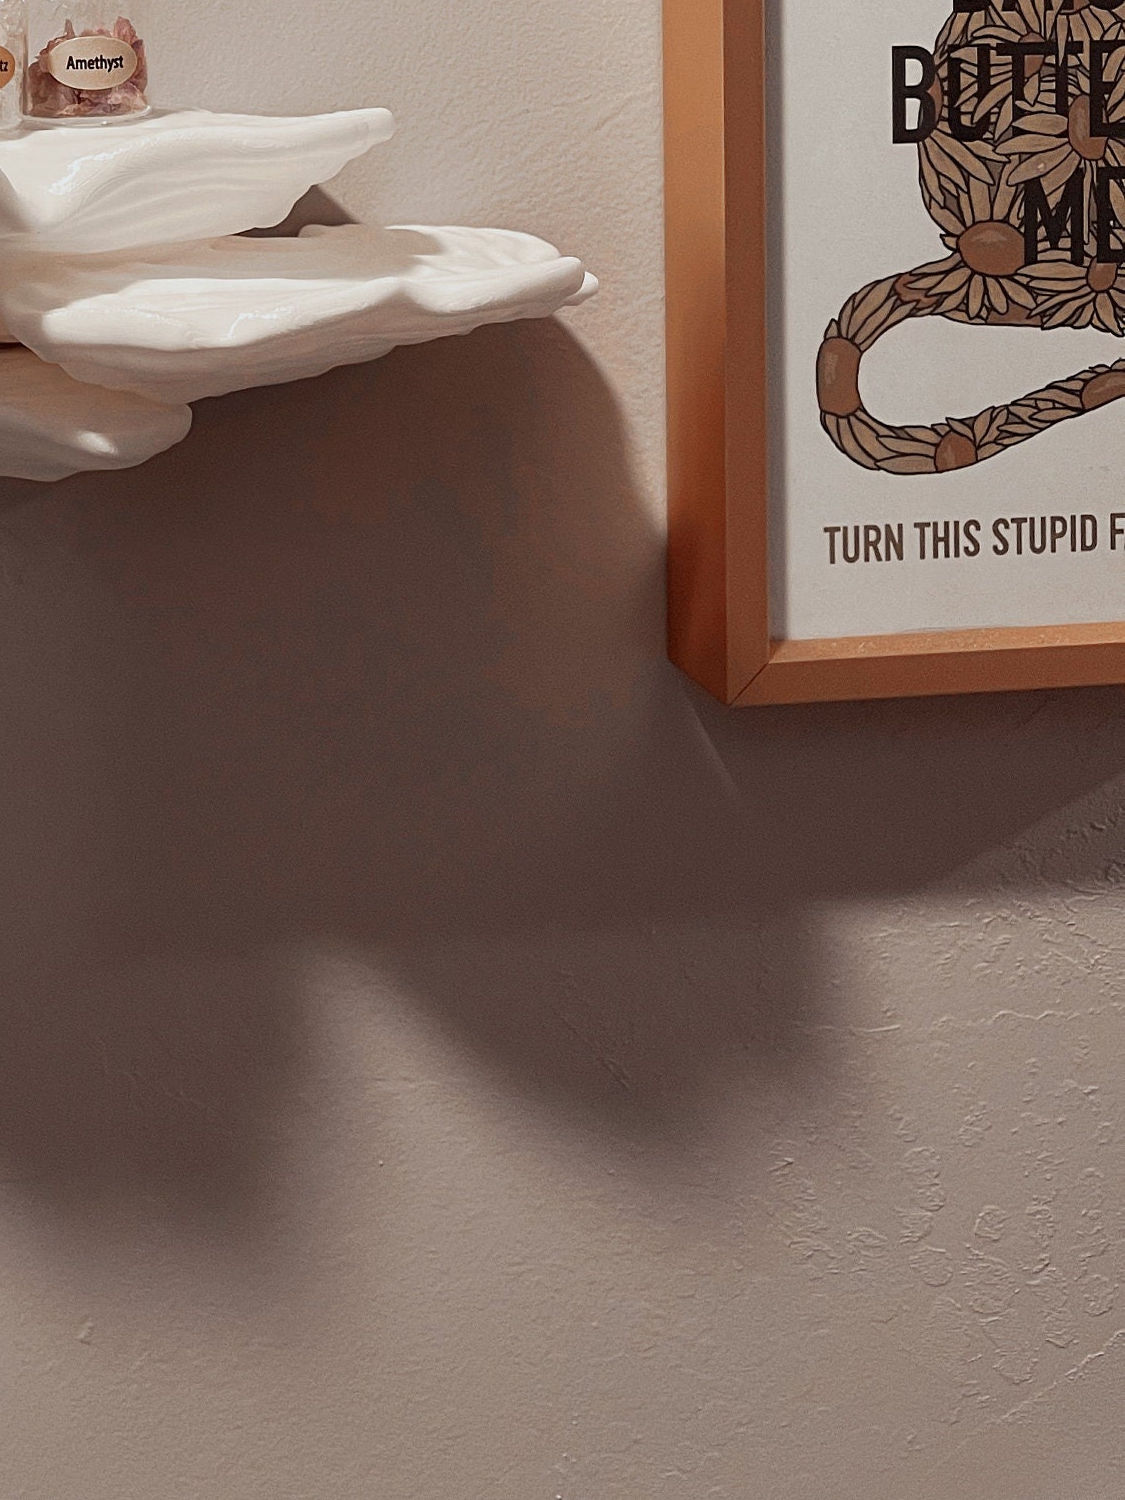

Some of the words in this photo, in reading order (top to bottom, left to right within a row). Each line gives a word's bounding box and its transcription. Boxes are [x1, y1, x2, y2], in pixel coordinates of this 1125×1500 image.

[66, 54, 124, 73] Amethyst
[823, 522, 904, 565] TURN
[913, 518, 981, 560] THIS
[991, 513, 1098, 556] STUPID
[1110, 512, 1125, 550] F
